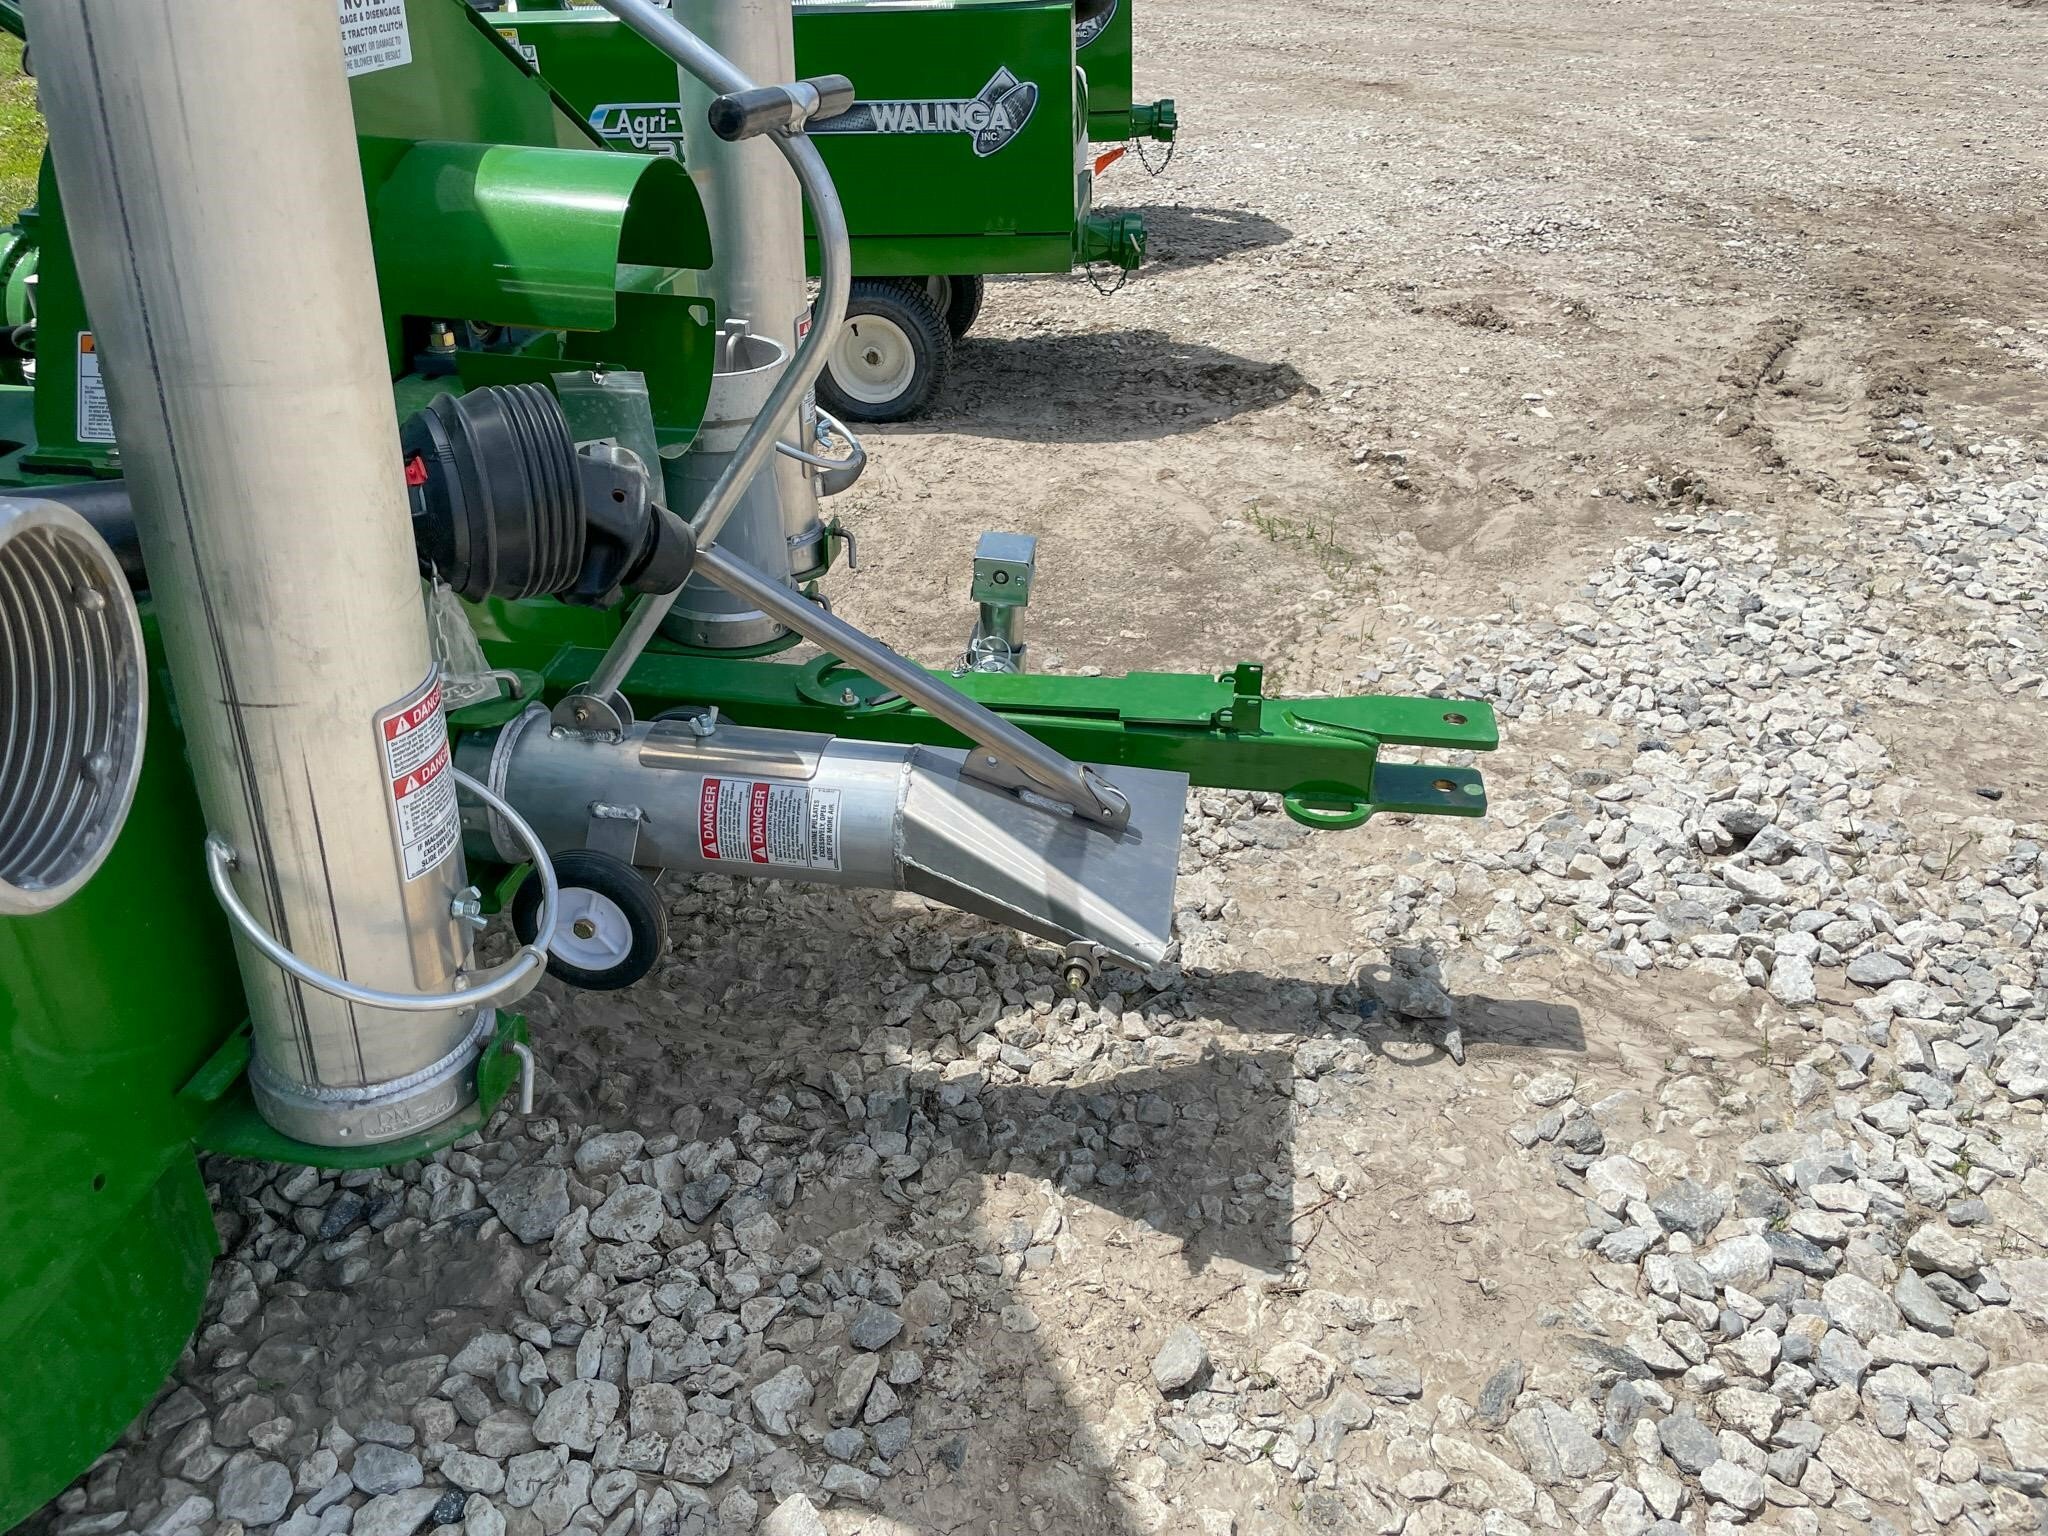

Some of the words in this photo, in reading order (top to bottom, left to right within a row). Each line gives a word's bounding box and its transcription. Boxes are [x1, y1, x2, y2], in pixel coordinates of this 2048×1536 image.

[340, 13, 358, 25] GAGE
[365, 6, 401, 20] DISENGAGE
[347, 25, 377, 39] TRACTOR
[379, 20, 403, 33] CLUTCH
[343, 43, 367, 56] LOWLY!
[376, 37, 395, 49] DAMAGE
[354, 55, 373, 68] BLOWER
[374, 53, 385, 63] WILL
[385, 49, 401, 61] RESULT
[616, 108, 682, 149] Agri-
[870, 101, 1012, 132] WALINGA
[981, 132, 1000, 141] INC.
[413, 683, 442, 724] DANGE
[422, 742, 449, 781] DANGE
[703, 785, 717, 839] DANGER
[752, 790, 766, 844] DANGER
[811, 800, 819, 829] PULSATES
[421, 851, 438, 867] SLIDE
